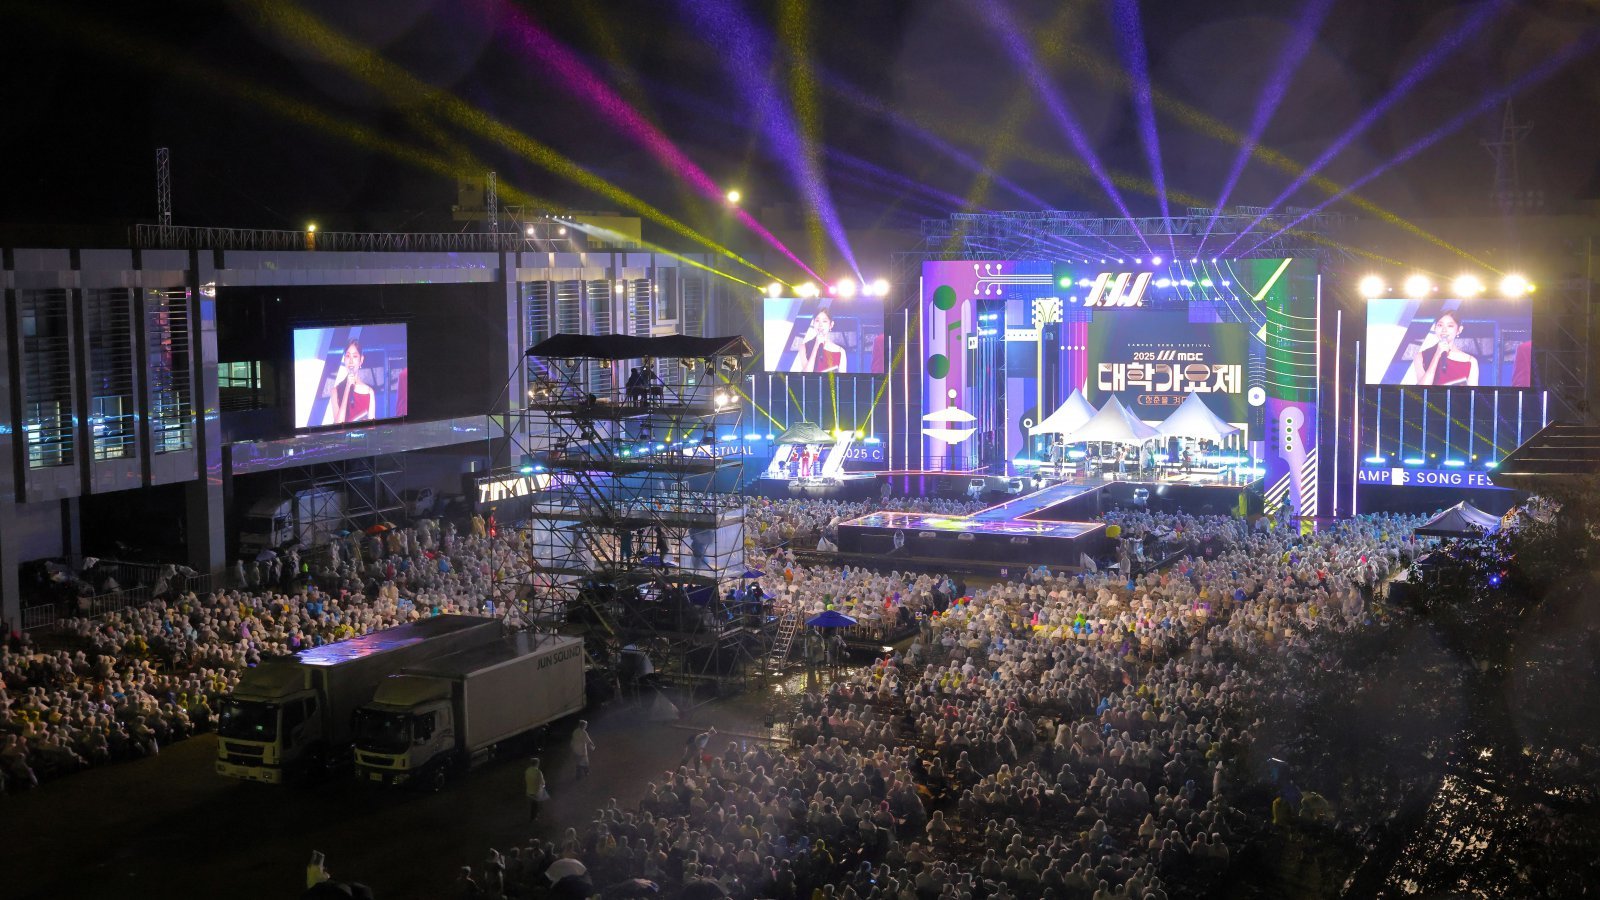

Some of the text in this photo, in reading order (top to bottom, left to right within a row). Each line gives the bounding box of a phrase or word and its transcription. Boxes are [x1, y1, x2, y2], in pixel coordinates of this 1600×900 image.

[1133, 352, 1155, 361] 2025
[1098, 361, 1242, 394] 대학가요제
[1417, 472, 1462, 485] SONG
[537, 646, 580, 670] JUN SOUND
